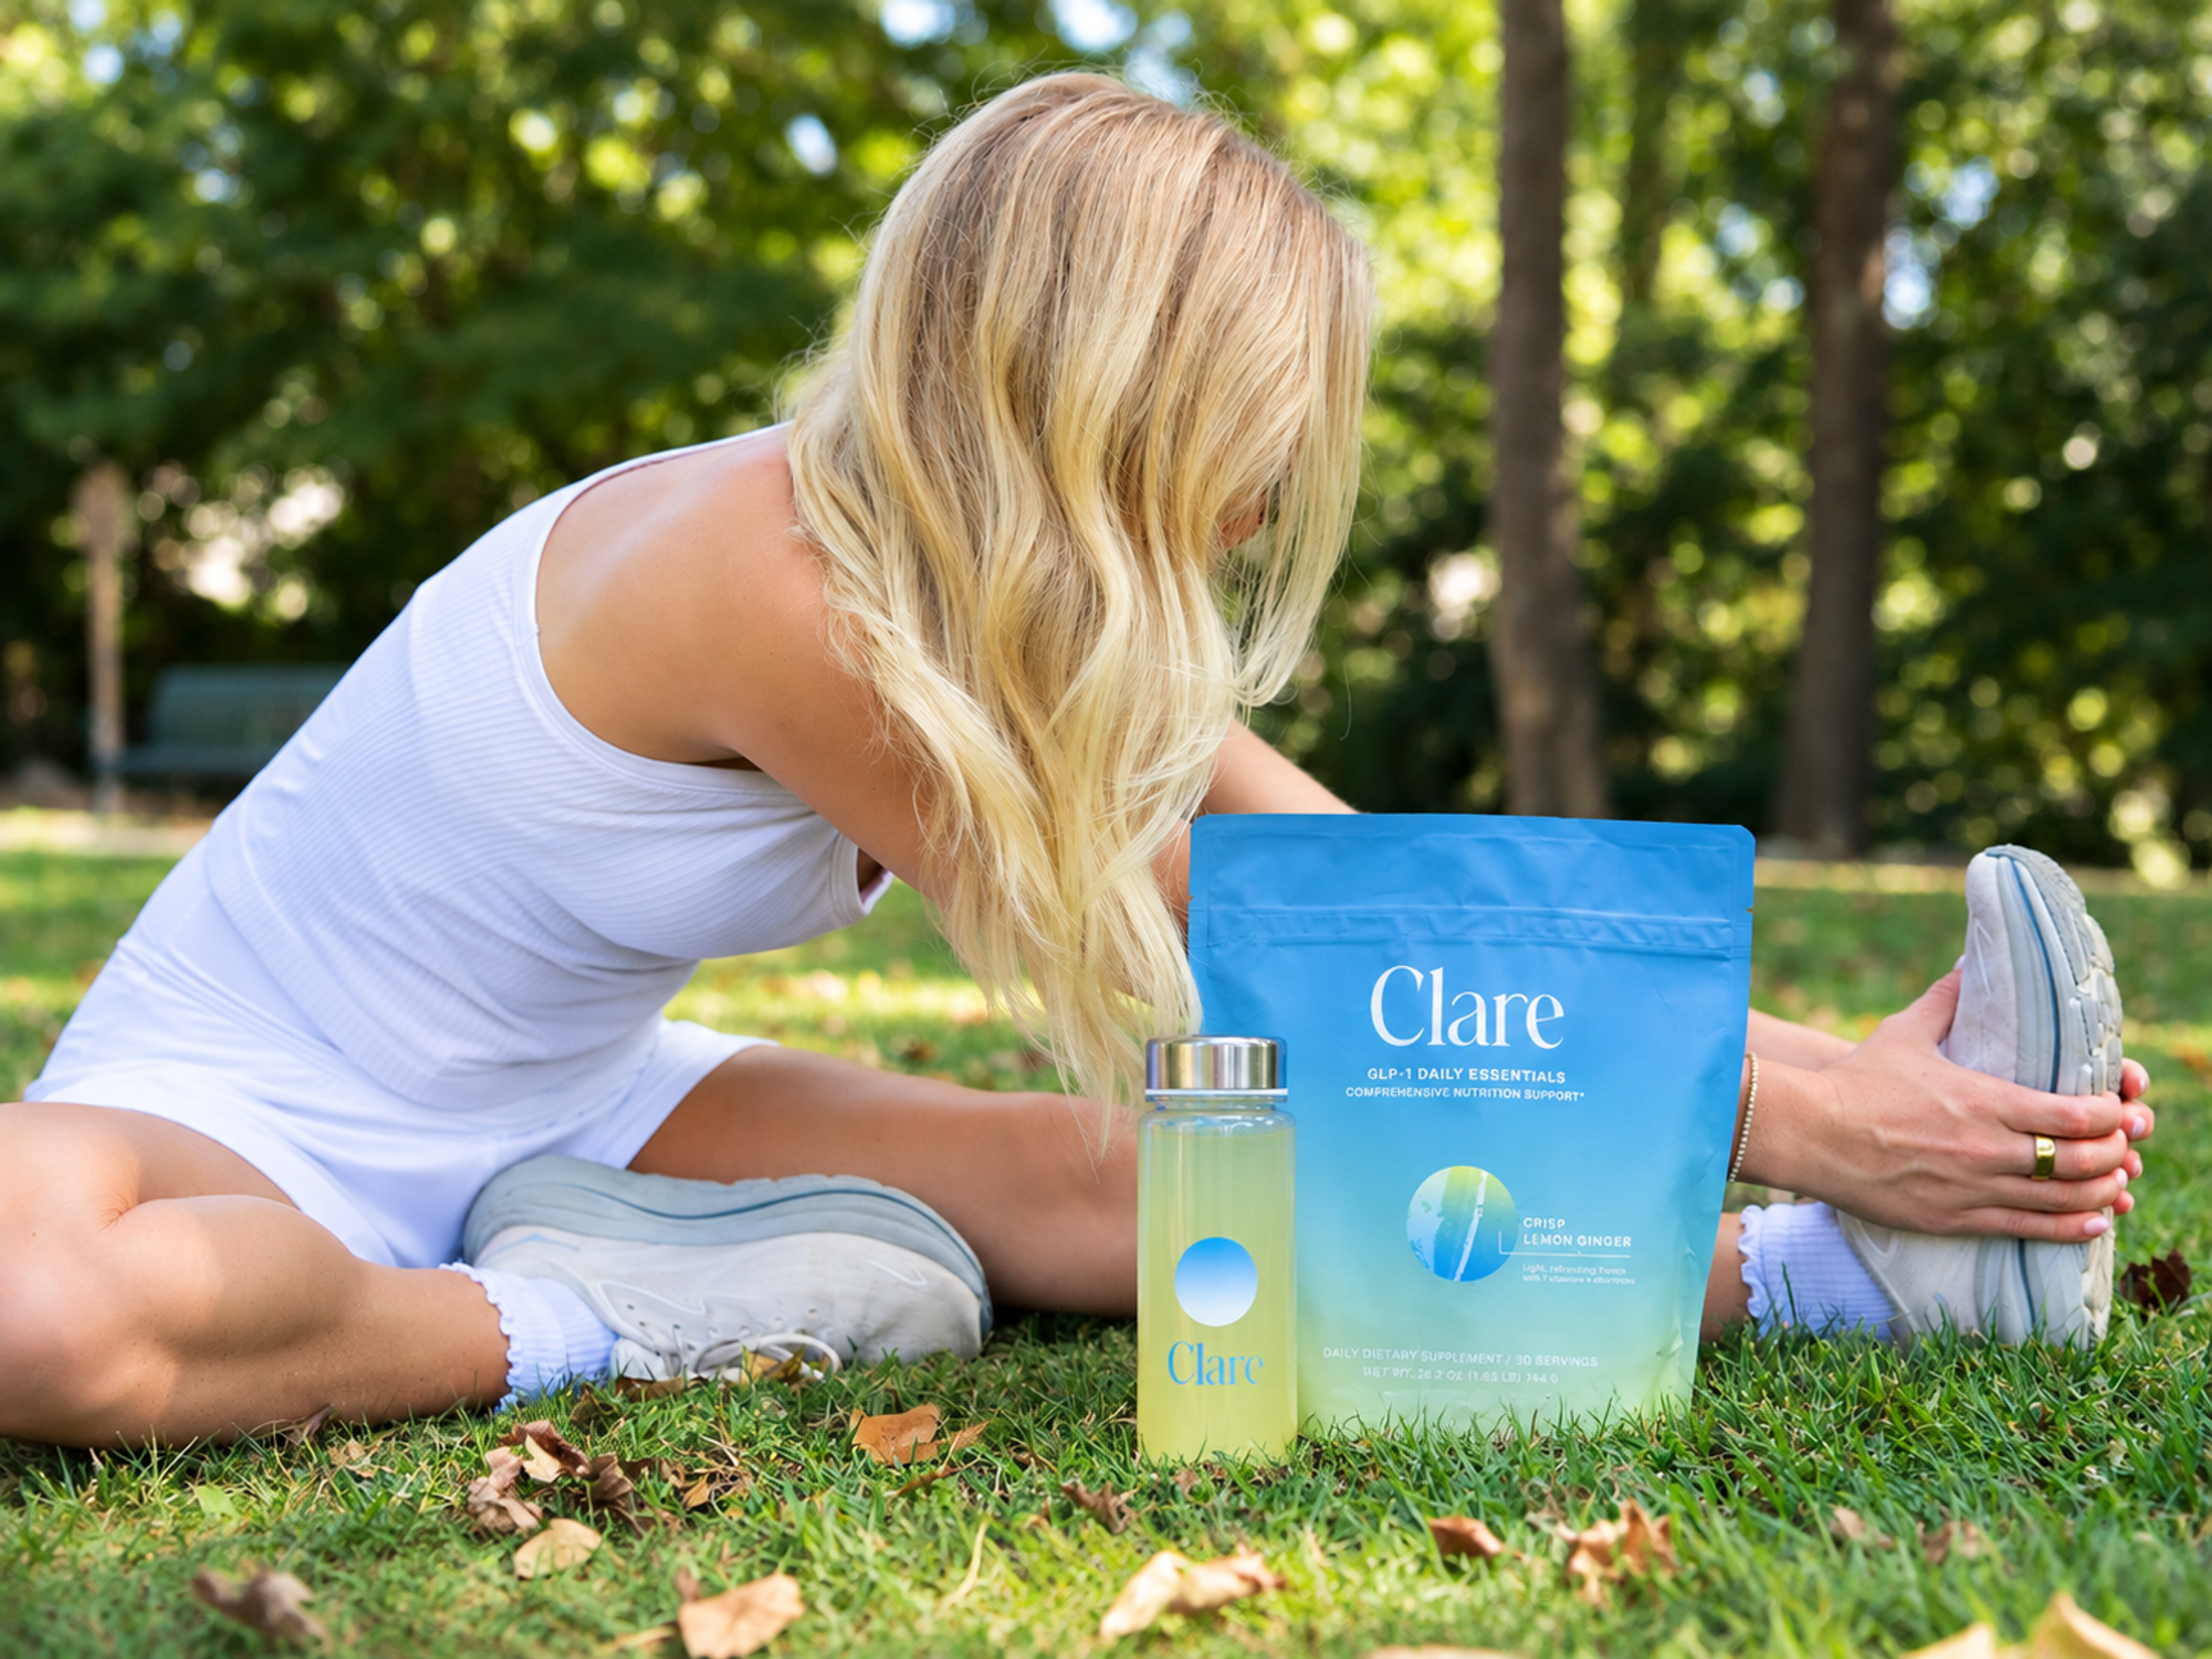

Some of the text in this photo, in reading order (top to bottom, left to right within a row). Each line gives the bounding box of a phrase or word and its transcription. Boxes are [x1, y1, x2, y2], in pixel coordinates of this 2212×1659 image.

[1370, 965, 1564, 1049] Clare
[1368, 1068, 1566, 1084] GLP-1 DAILY ESSENTIALS
[1346, 1087, 1449, 1099] COMPREHENSIVE
[1454, 1088, 1521, 1099] NUTRITION
[1523, 1217, 1565, 1229] CRISP
[1523, 1233, 1631, 1247] LEMON GINGER
[1168, 1340, 1263, 1385] Clare
[1323, 1347, 1359, 1358] DAILY
[1362, 1349, 1417, 1360] DIETARY
[1421, 1351, 1503, 1365] SUPPLEMENT
[1535, 1356, 1598, 1367] SERVINGS
